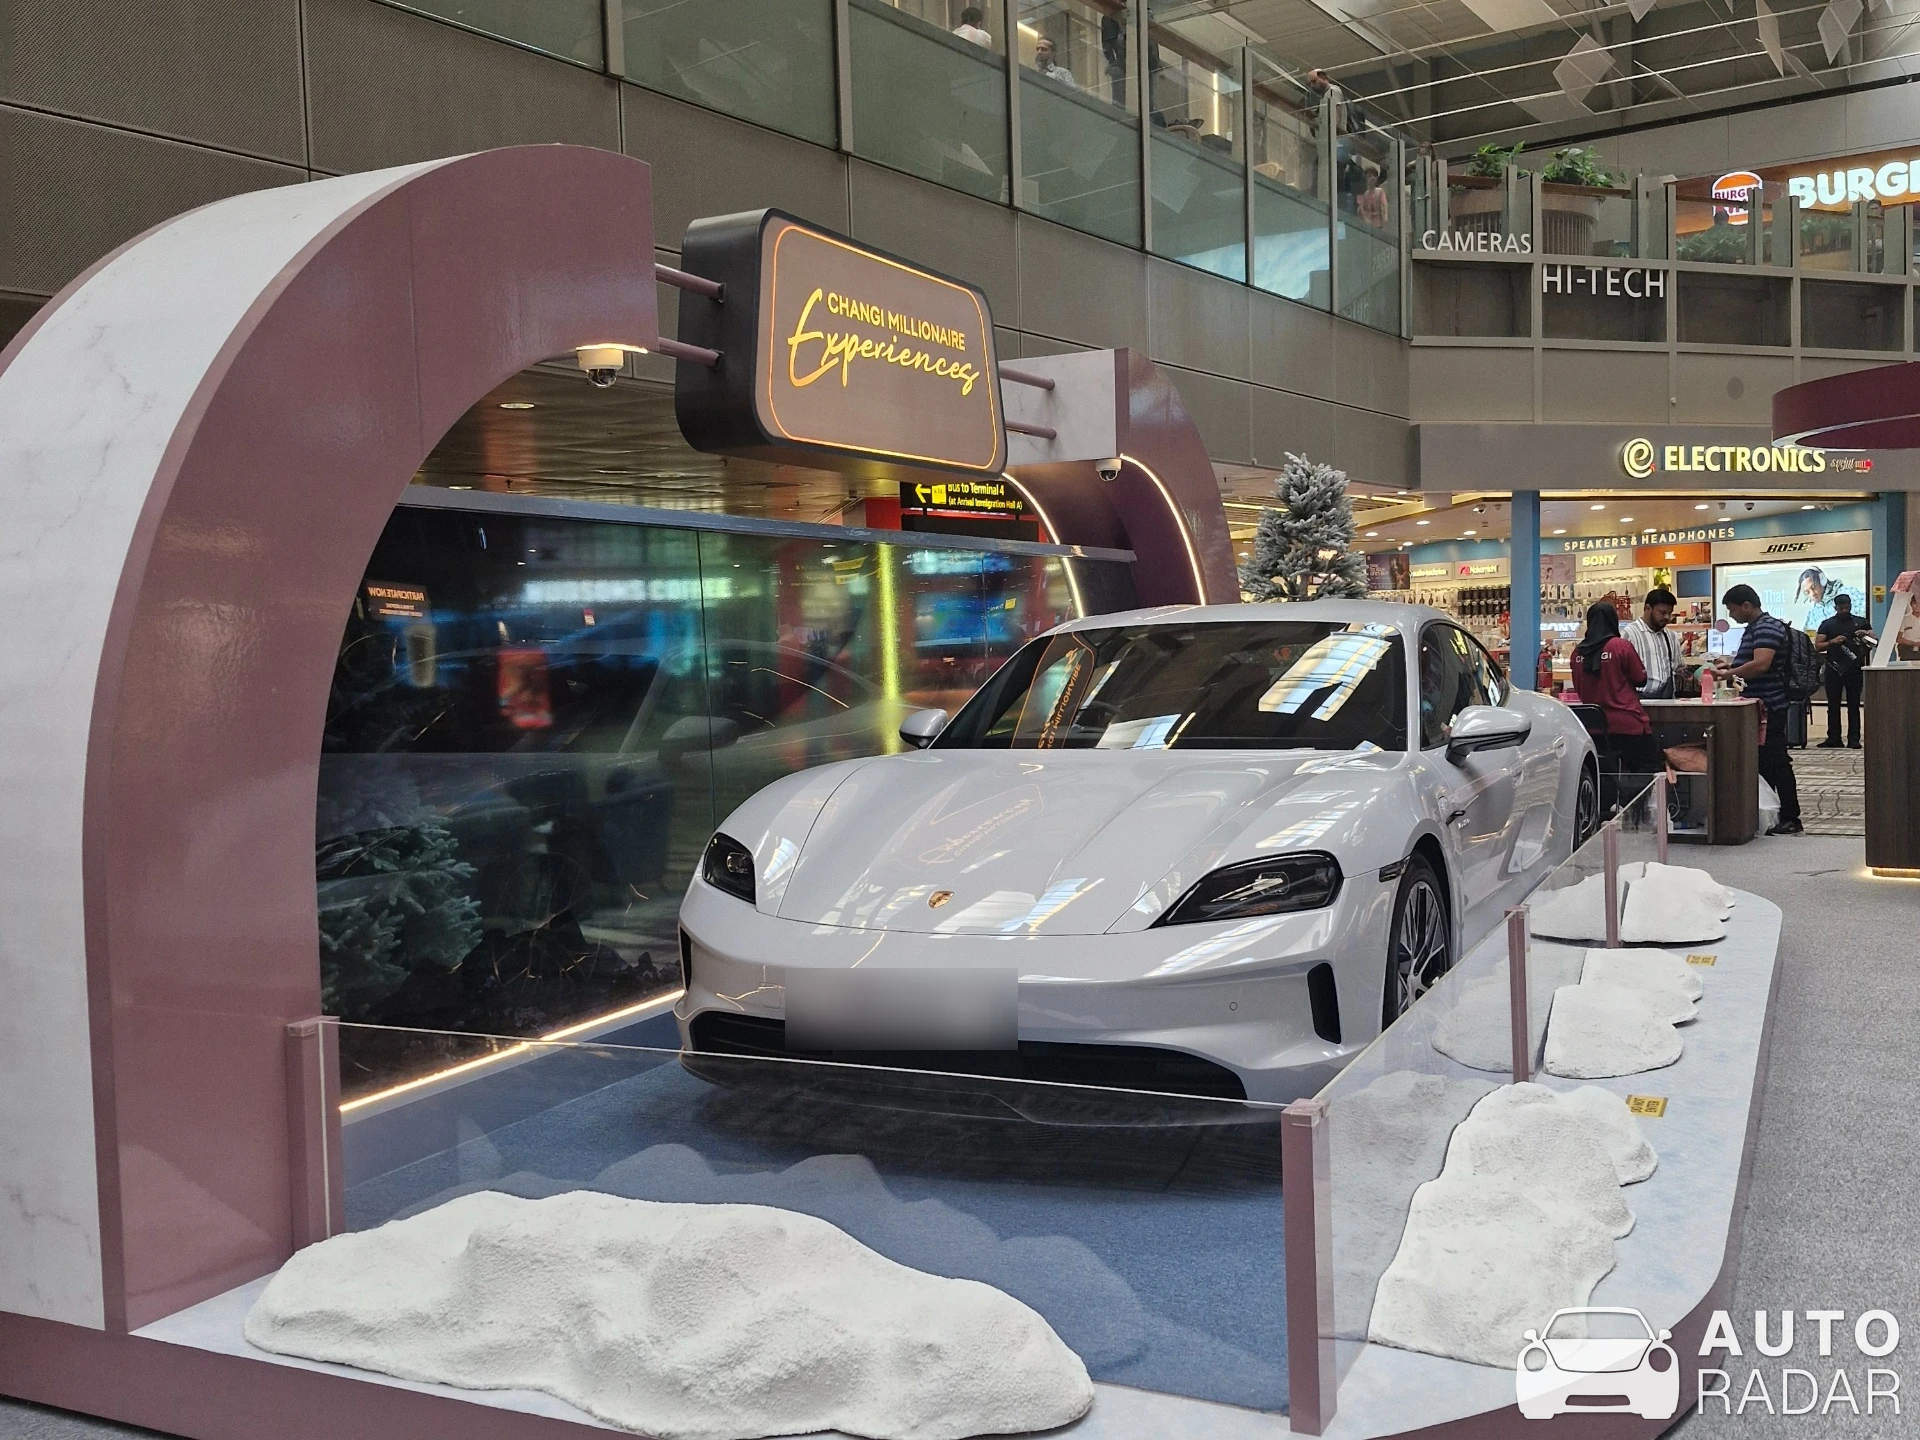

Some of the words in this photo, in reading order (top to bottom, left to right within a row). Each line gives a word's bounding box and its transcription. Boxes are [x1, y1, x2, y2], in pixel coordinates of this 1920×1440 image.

[1714, 187, 1749, 199] BURG
[1422, 229, 1532, 254] CAMERAS
[1542, 264, 1665, 298] HI-TECH
[827, 292, 885, 327] CHANGI
[888, 310, 966, 351] MILLIONAIRE
[787, 287, 980, 396] Experiences
[1664, 445, 1826, 473] ELECTRONICS
[961, 482, 970, 494] to
[969, 482, 999, 496] Terminal
[999, 484, 1005, 496] 4
[1564, 536, 1627, 551] SPEAKERS
[1630, 534, 1638, 546] &
[1641, 527, 1736, 545] HEADPHONES
[1760, 542, 1814, 555] BOSE
[1582, 554, 1617, 567] SONY
[1763, 588, 1786, 604] That
